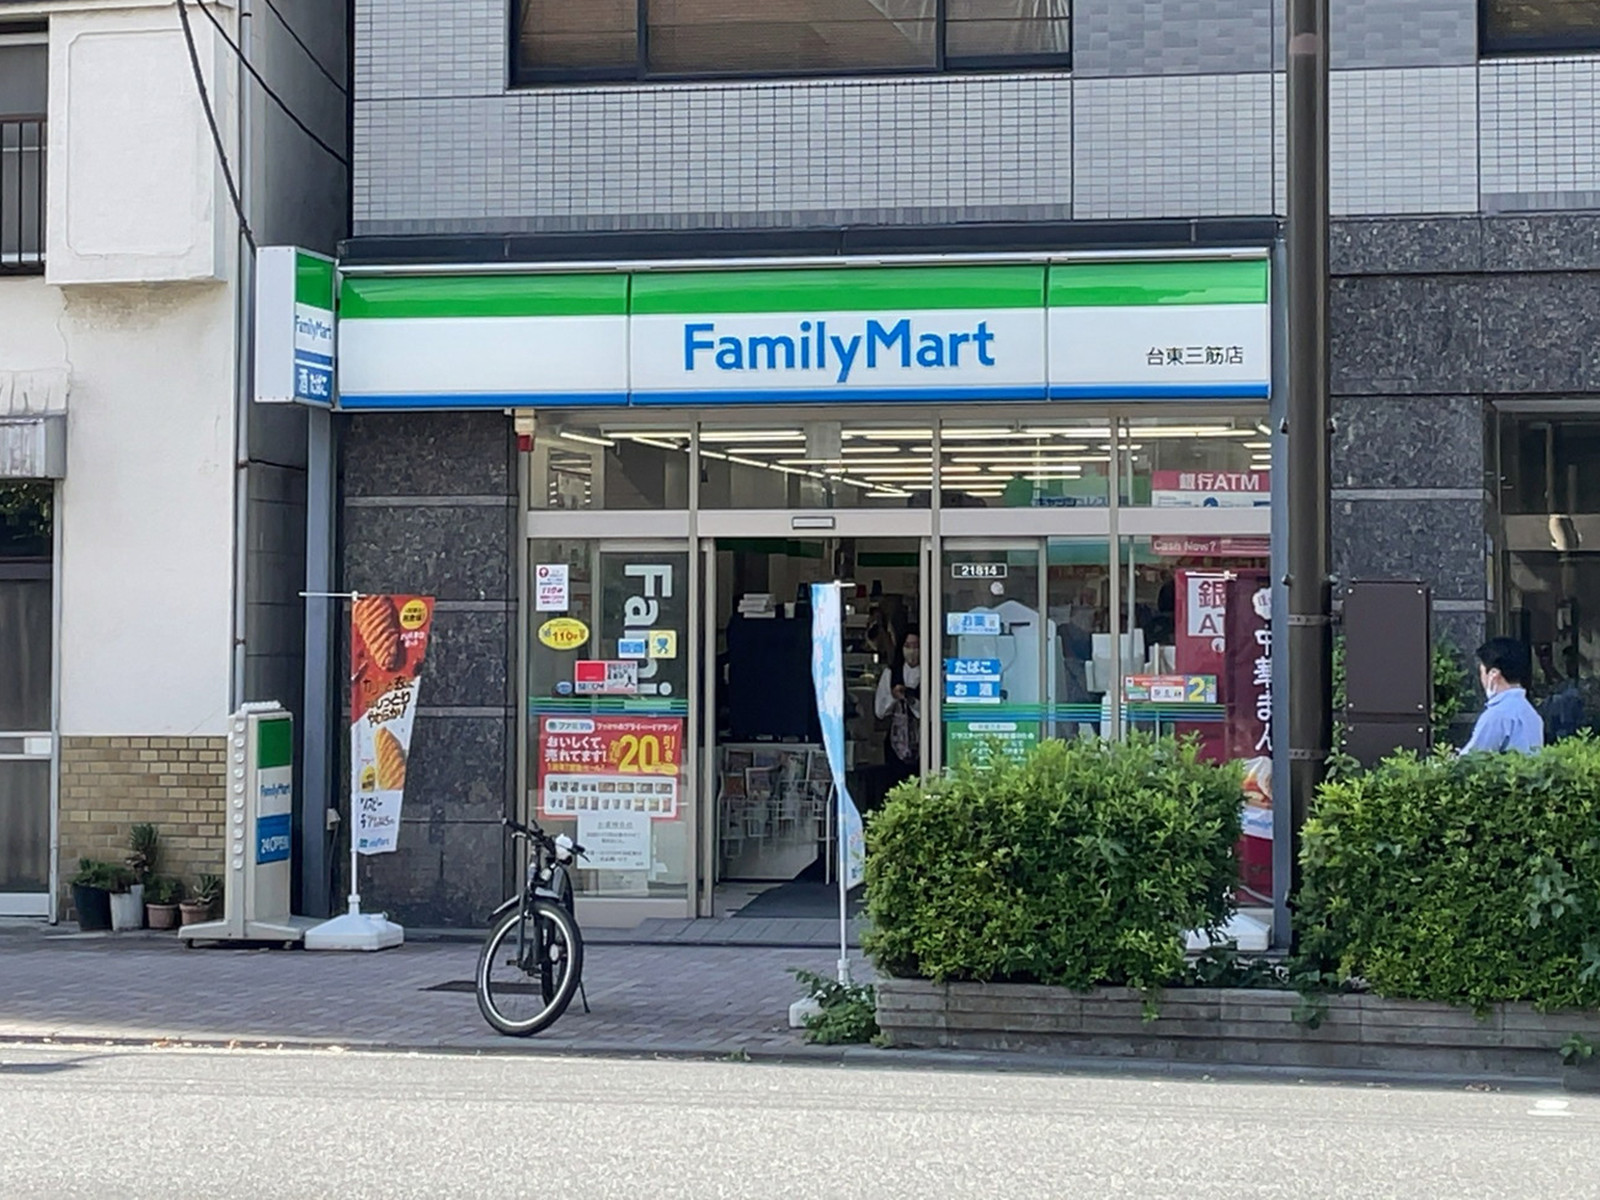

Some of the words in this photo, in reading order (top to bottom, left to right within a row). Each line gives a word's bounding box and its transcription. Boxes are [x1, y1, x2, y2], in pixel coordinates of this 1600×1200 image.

[294, 314, 332, 342] FamilyMart
[684, 318, 996, 384] FamilyMart
[1146, 345, 1244, 366] 台東三筋店
[1178, 472, 1260, 491] 銀行ATM
[961, 565, 998, 577] 21814
[1198, 580, 1226, 609] 銀
[954, 660, 994, 674] たばこ
[1189, 676, 1206, 703] 2
[547, 736, 607, 749] おいしくて、
[618, 735, 660, 774] 20
[260, 784, 290, 799] FamilyMart
